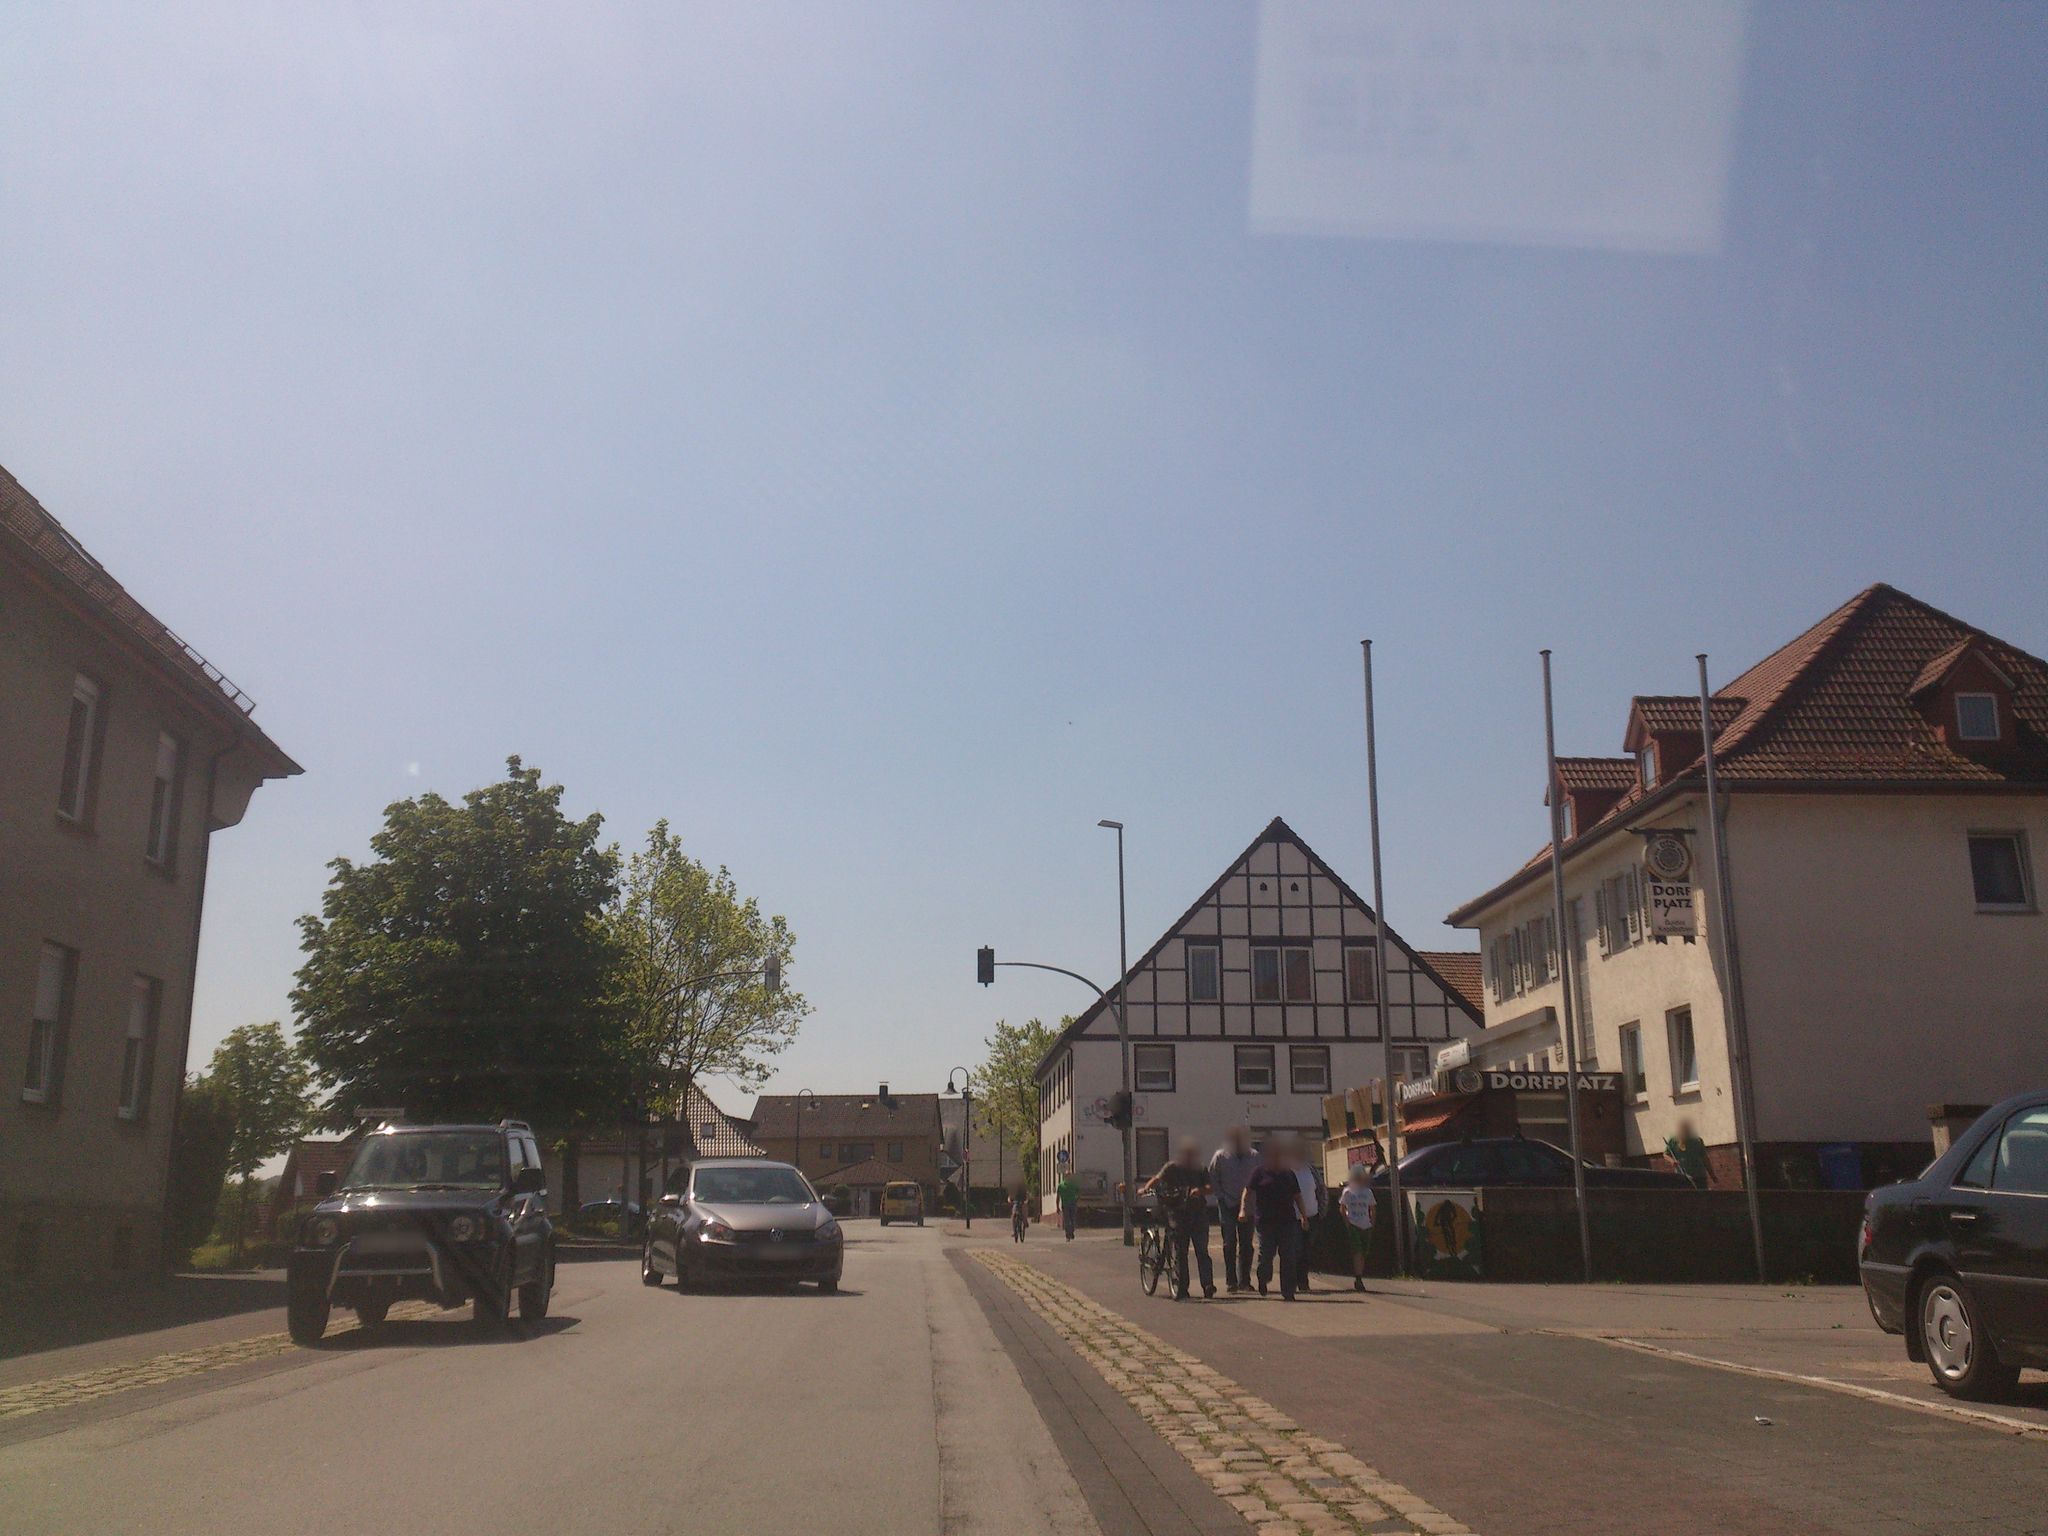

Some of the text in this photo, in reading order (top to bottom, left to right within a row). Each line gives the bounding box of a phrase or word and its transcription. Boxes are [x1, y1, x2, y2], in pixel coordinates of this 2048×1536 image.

[1653, 885, 1691, 897] DORF
[1654, 898, 1692, 914] PLATZ
[1491, 1073, 1616, 1090] DORFPATZ
